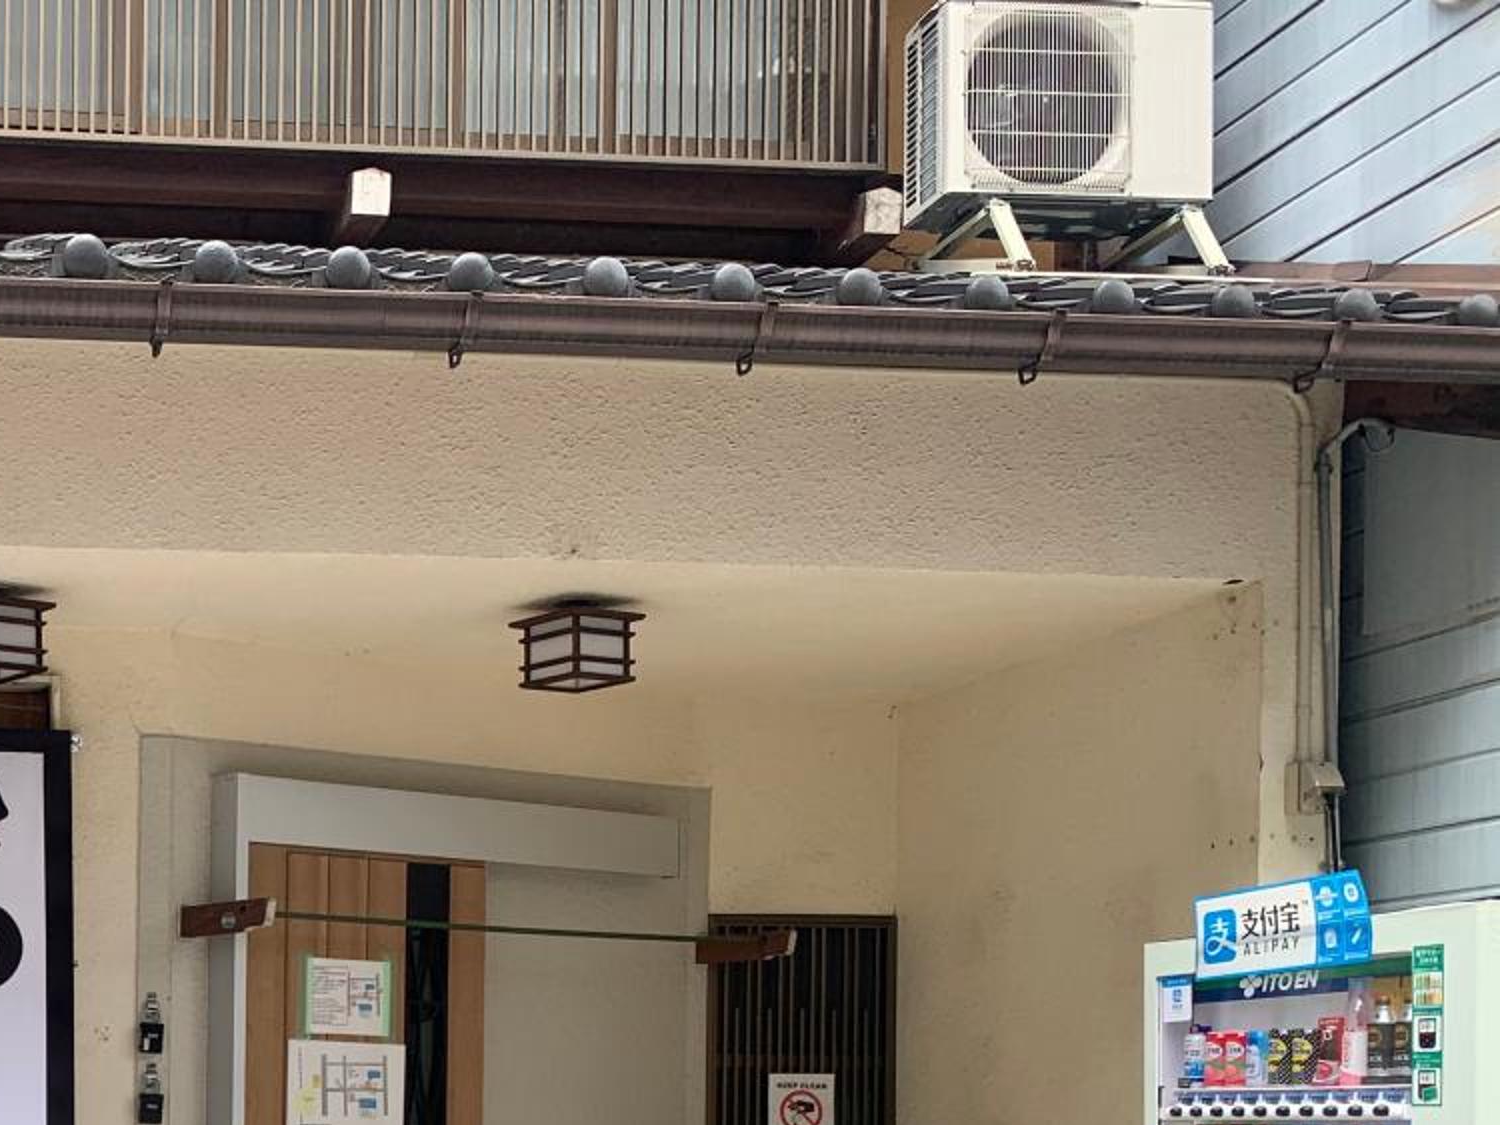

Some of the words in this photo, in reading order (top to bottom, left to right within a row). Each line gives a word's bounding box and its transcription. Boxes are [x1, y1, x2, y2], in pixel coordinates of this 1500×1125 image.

[1241, 902, 1300, 940] 支付宝
[1243, 935, 1300, 956] ALIPAY
